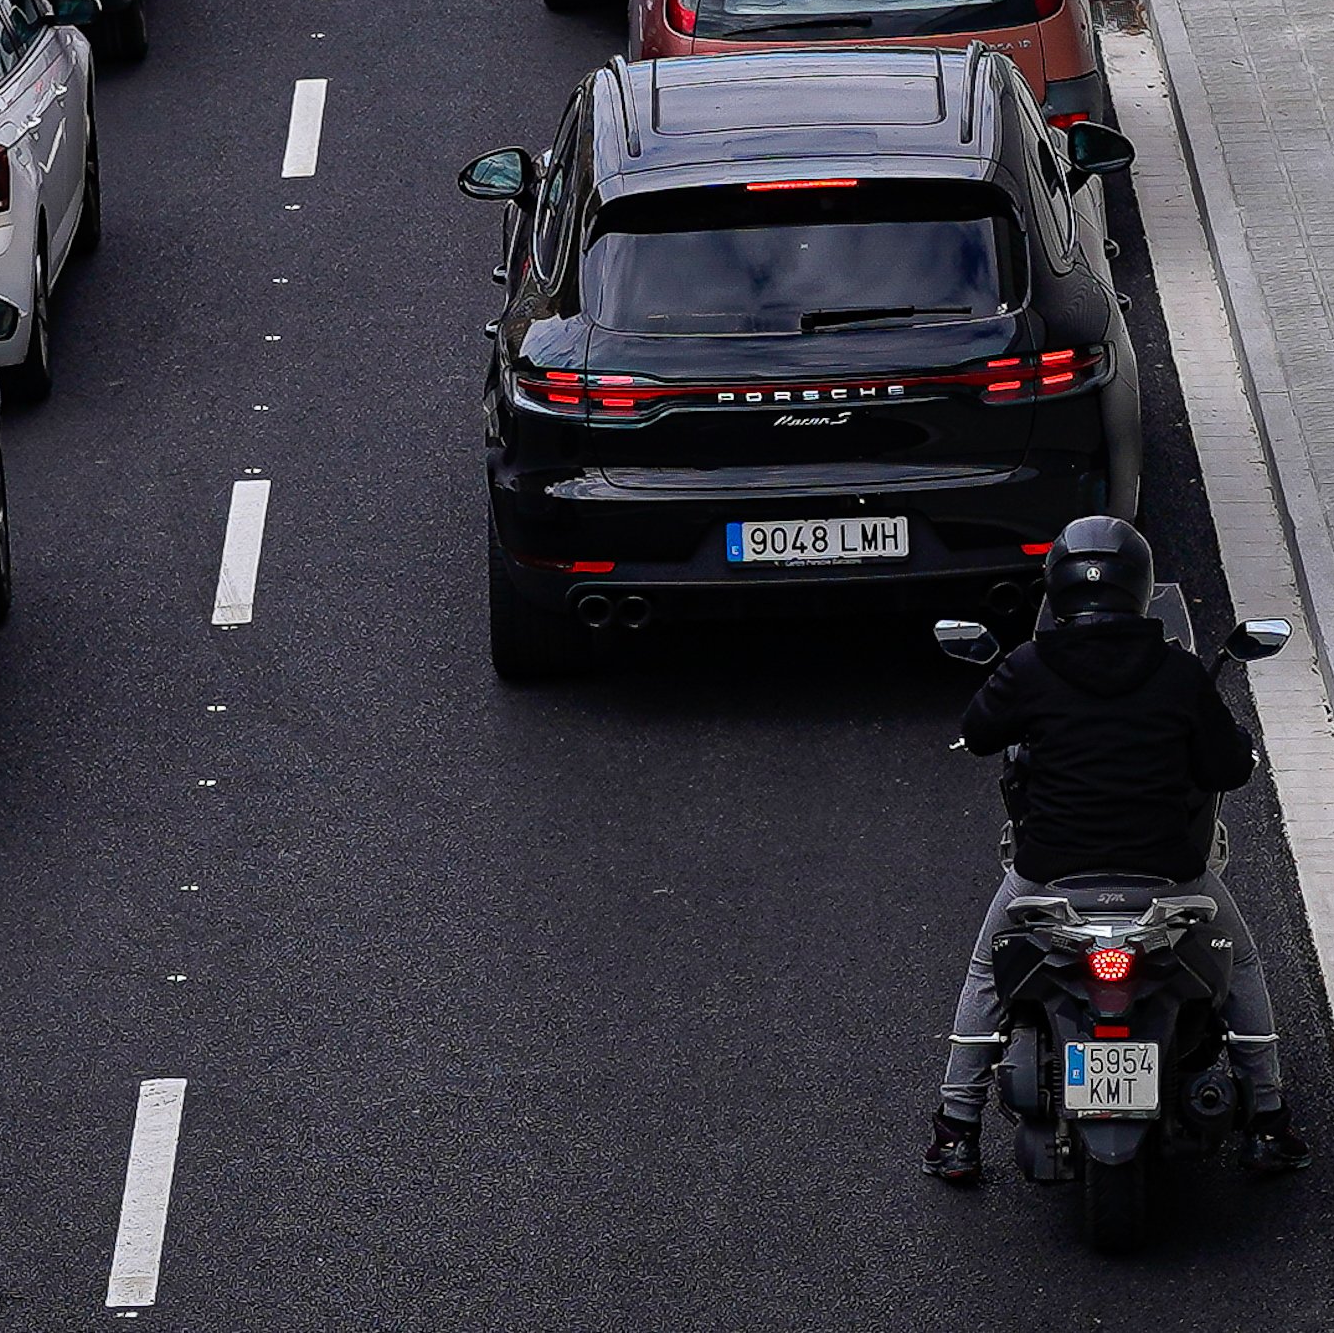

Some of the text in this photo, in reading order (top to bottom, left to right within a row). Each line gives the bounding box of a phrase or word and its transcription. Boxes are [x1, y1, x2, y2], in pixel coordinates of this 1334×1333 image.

[717, 385, 905, 403] PORSCHE
[750, 525, 829, 555] 9048
[840, 521, 899, 552] LMH
[1090, 1048, 1154, 1076] 5954
[1090, 1078, 1137, 1105] KMT
